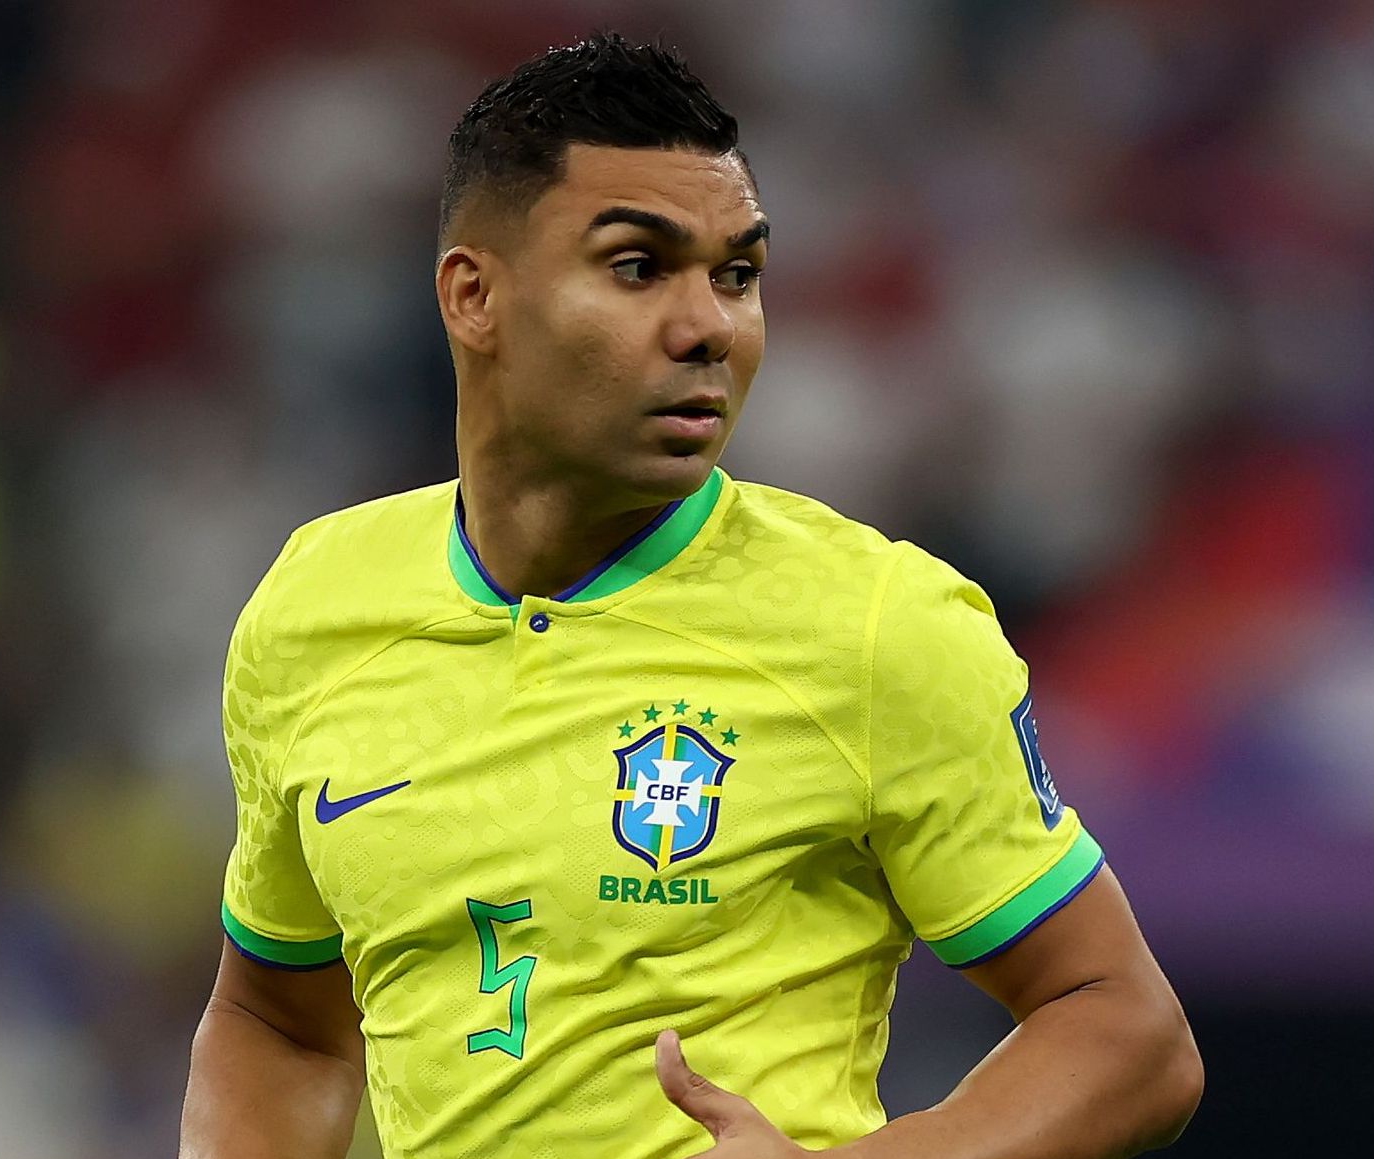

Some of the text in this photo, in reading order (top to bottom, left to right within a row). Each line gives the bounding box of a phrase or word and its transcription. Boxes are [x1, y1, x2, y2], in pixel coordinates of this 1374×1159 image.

[647, 784, 690, 801] CBF
[599, 875, 719, 905] BRASIL
[466, 897, 537, 1060] 5
